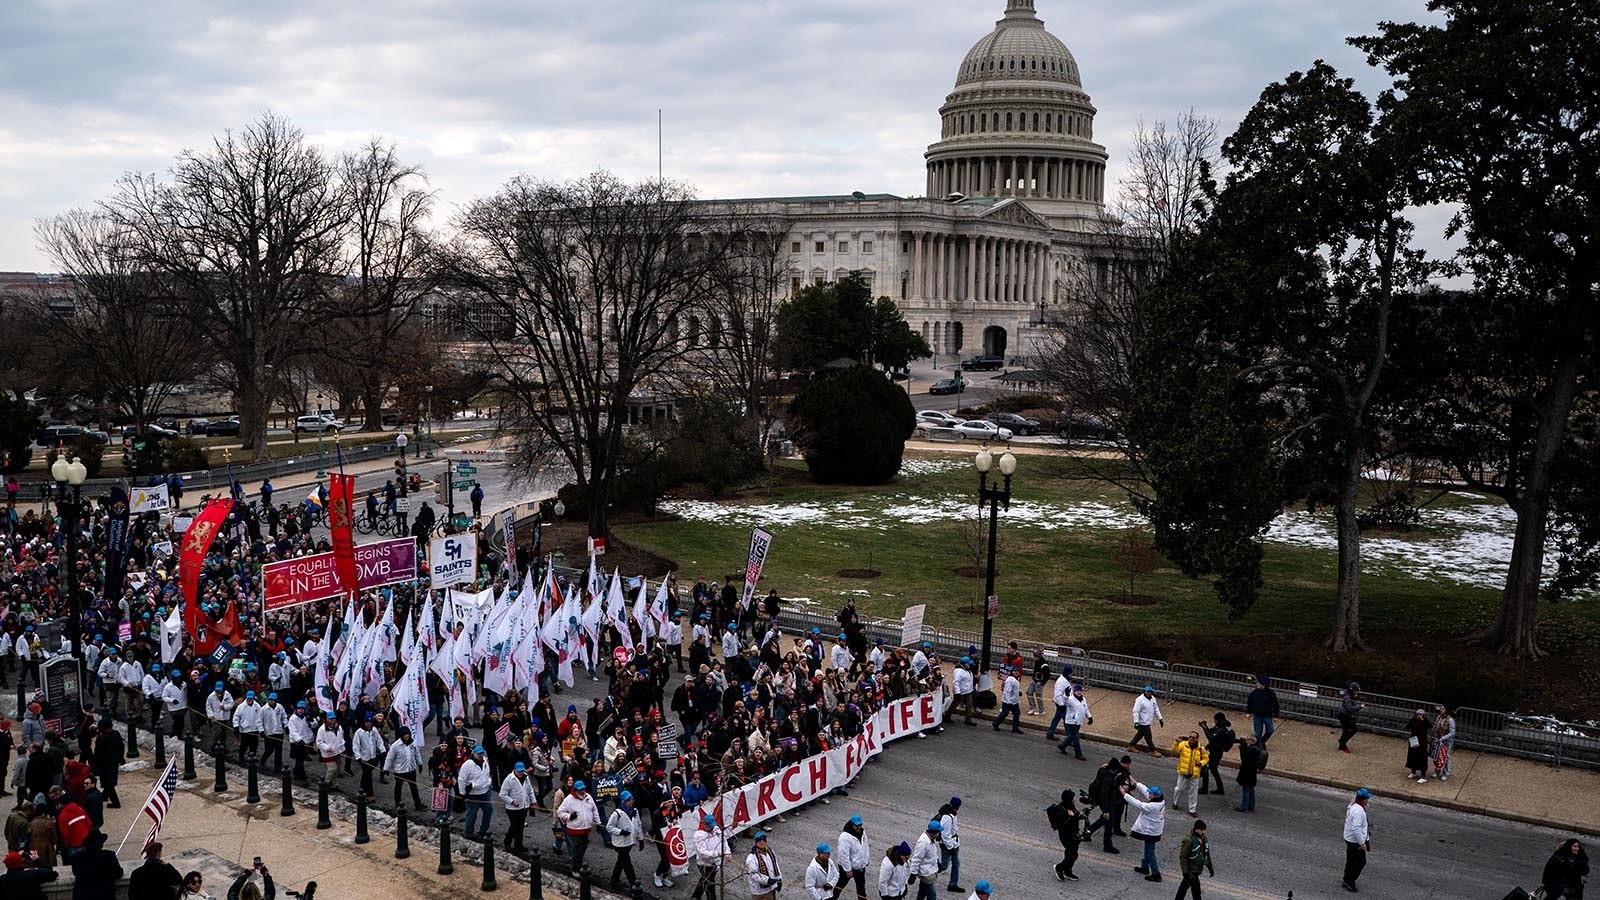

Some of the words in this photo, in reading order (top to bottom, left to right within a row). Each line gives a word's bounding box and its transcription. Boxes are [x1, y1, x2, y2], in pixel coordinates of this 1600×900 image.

[109, 519, 118, 550] Columbus
[115, 520, 124, 542] Knights
[751, 541, 766, 559] IS
[289, 556, 337, 576] EQUALI
[434, 559, 472, 574] SAINTS
[290, 577, 309, 595] IN
[312, 574, 330, 587] THE
[215, 646, 228, 660] LIFE
[697, 755, 828, 830] MARCH
[845, 720, 877, 779] FOR
[880, 696, 935, 739] IFE
